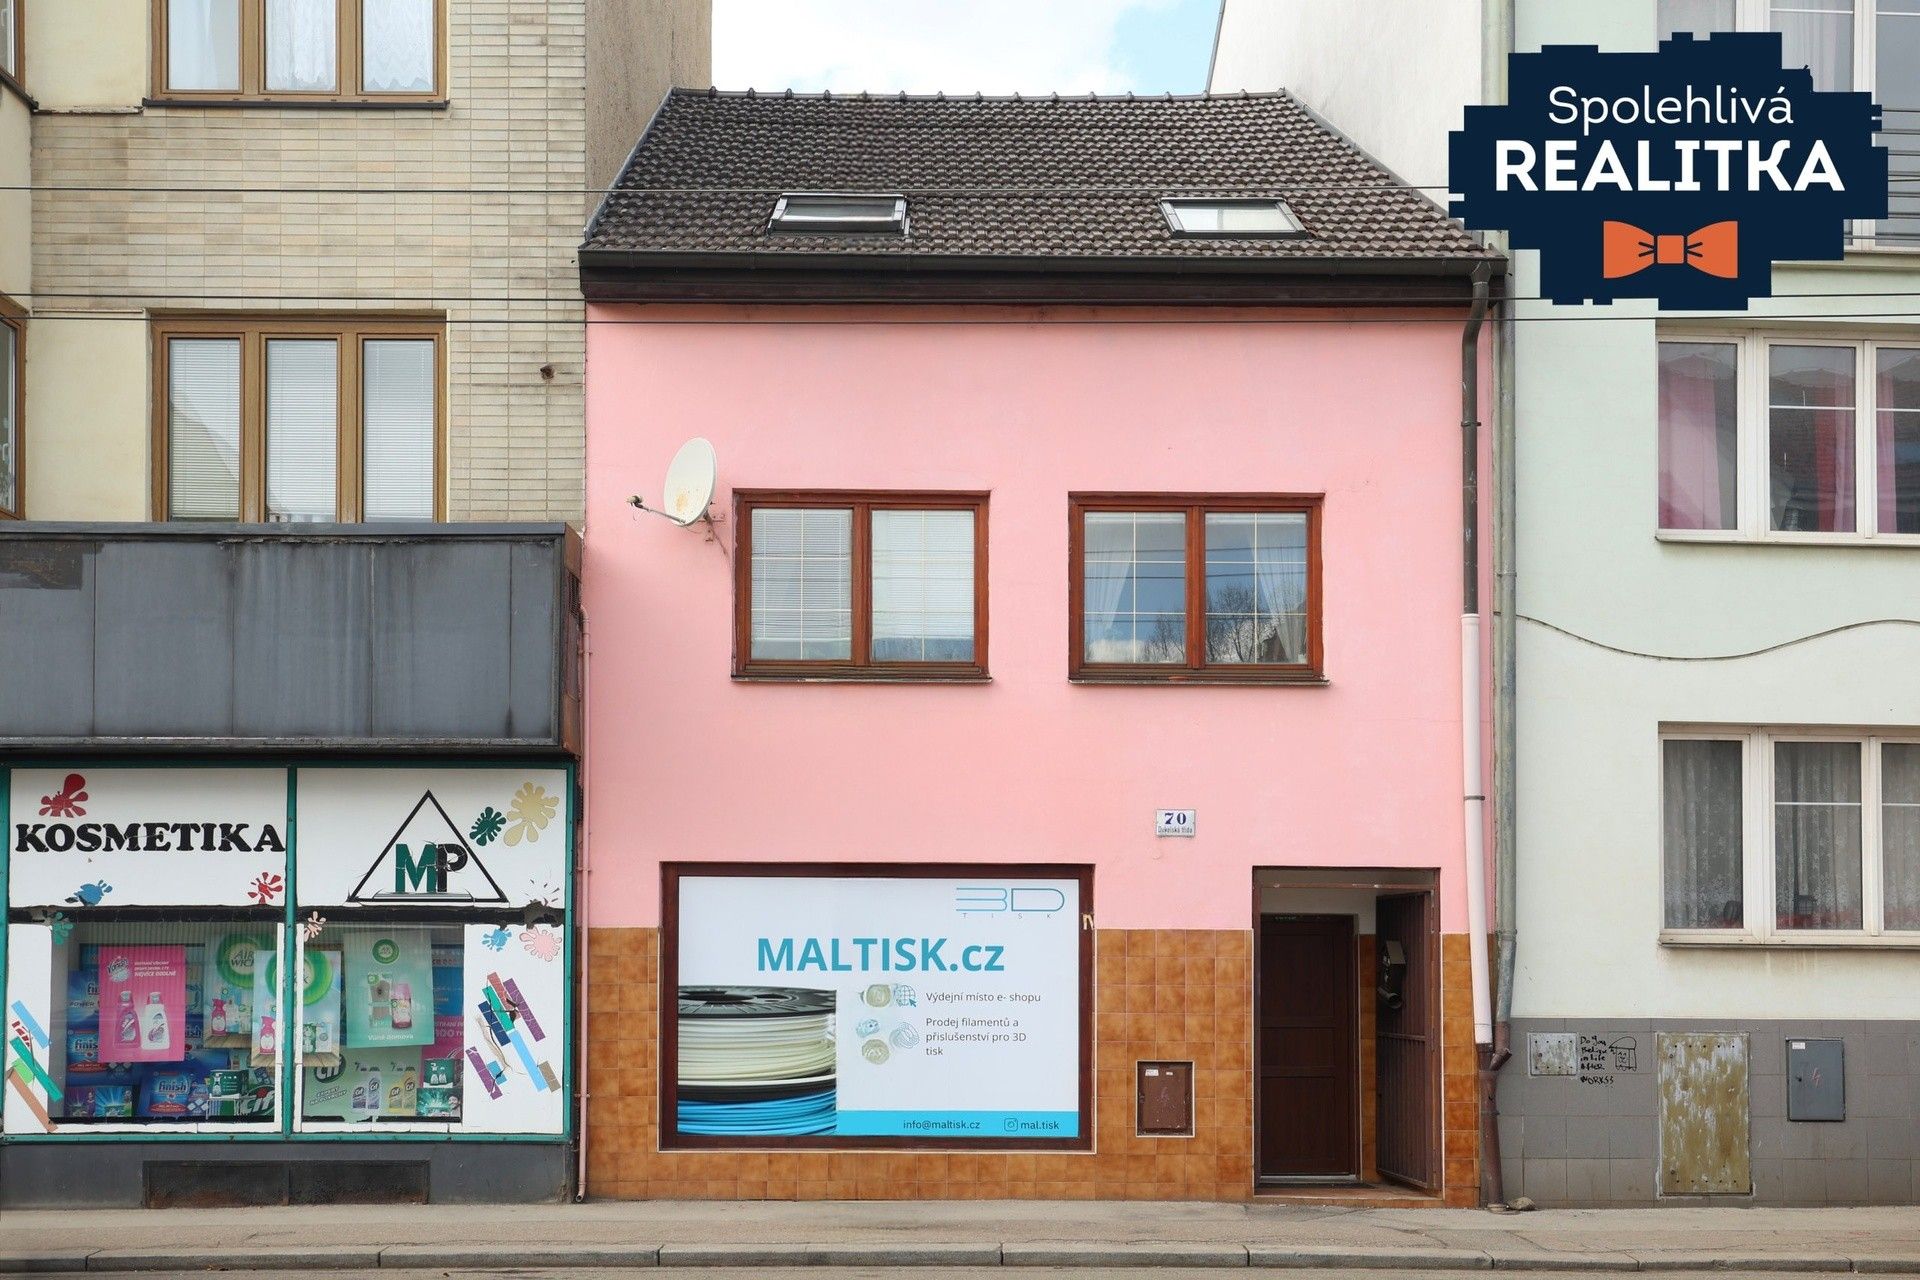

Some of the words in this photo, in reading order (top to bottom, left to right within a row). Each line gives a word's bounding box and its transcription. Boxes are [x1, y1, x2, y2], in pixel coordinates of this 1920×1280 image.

[1164, 812, 1187, 825] 70
[15, 823, 285, 853] KOSMETIKA
[396, 843, 468, 893] MP
[956, 887, 1065, 911] 3D
[757, 937, 1005, 972] MALTISK.cz
[926, 992, 963, 1003] Výdejní
[965, 992, 994, 1002] místo
[1009, 993, 1041, 1004] shopu
[926, 1017, 959, 1029] Prodej
[961, 1017, 1010, 1027] filamentů
[1013, 1019, 1019, 1027] a
[992, 1034, 1010, 1043] pro
[1013, 1033, 1027, 1041] 3D
[75, 1039, 99, 1050] finis
[926, 1047, 944, 1056] tisk
[159, 1080, 187, 1092] finish
[903, 1120, 980, 1130] info@maltisk.cz
[1020, 1120, 1060, 1130] mal.tisk
